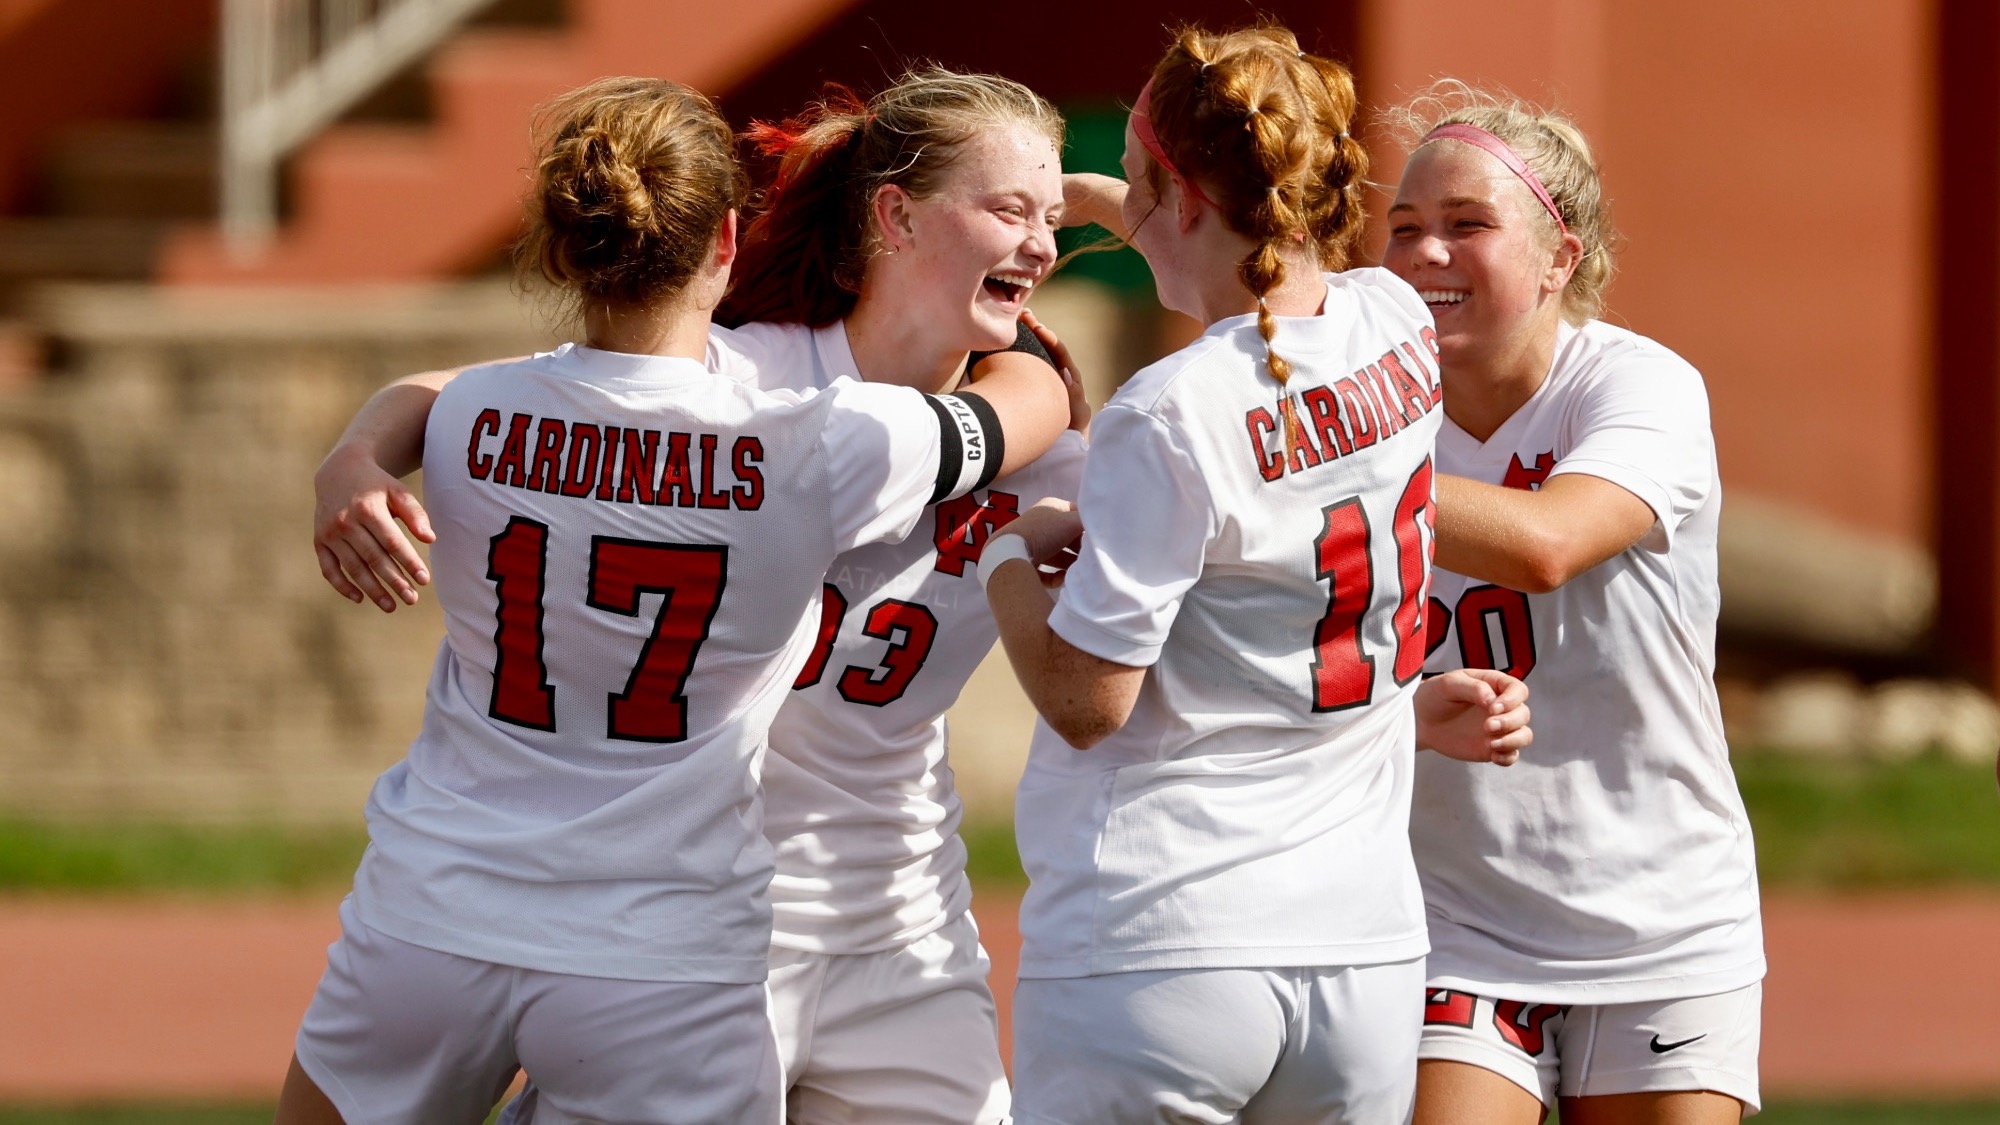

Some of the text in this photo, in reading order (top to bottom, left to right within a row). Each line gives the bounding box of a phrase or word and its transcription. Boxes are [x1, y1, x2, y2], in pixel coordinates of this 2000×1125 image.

[467, 408, 765, 511] CARDINALS
[1246, 326, 1441, 483] CARDINALS
[486, 515, 729, 743] 17
[830, 564, 964, 610] ATAPULT
[1310, 452, 1437, 713] 10
